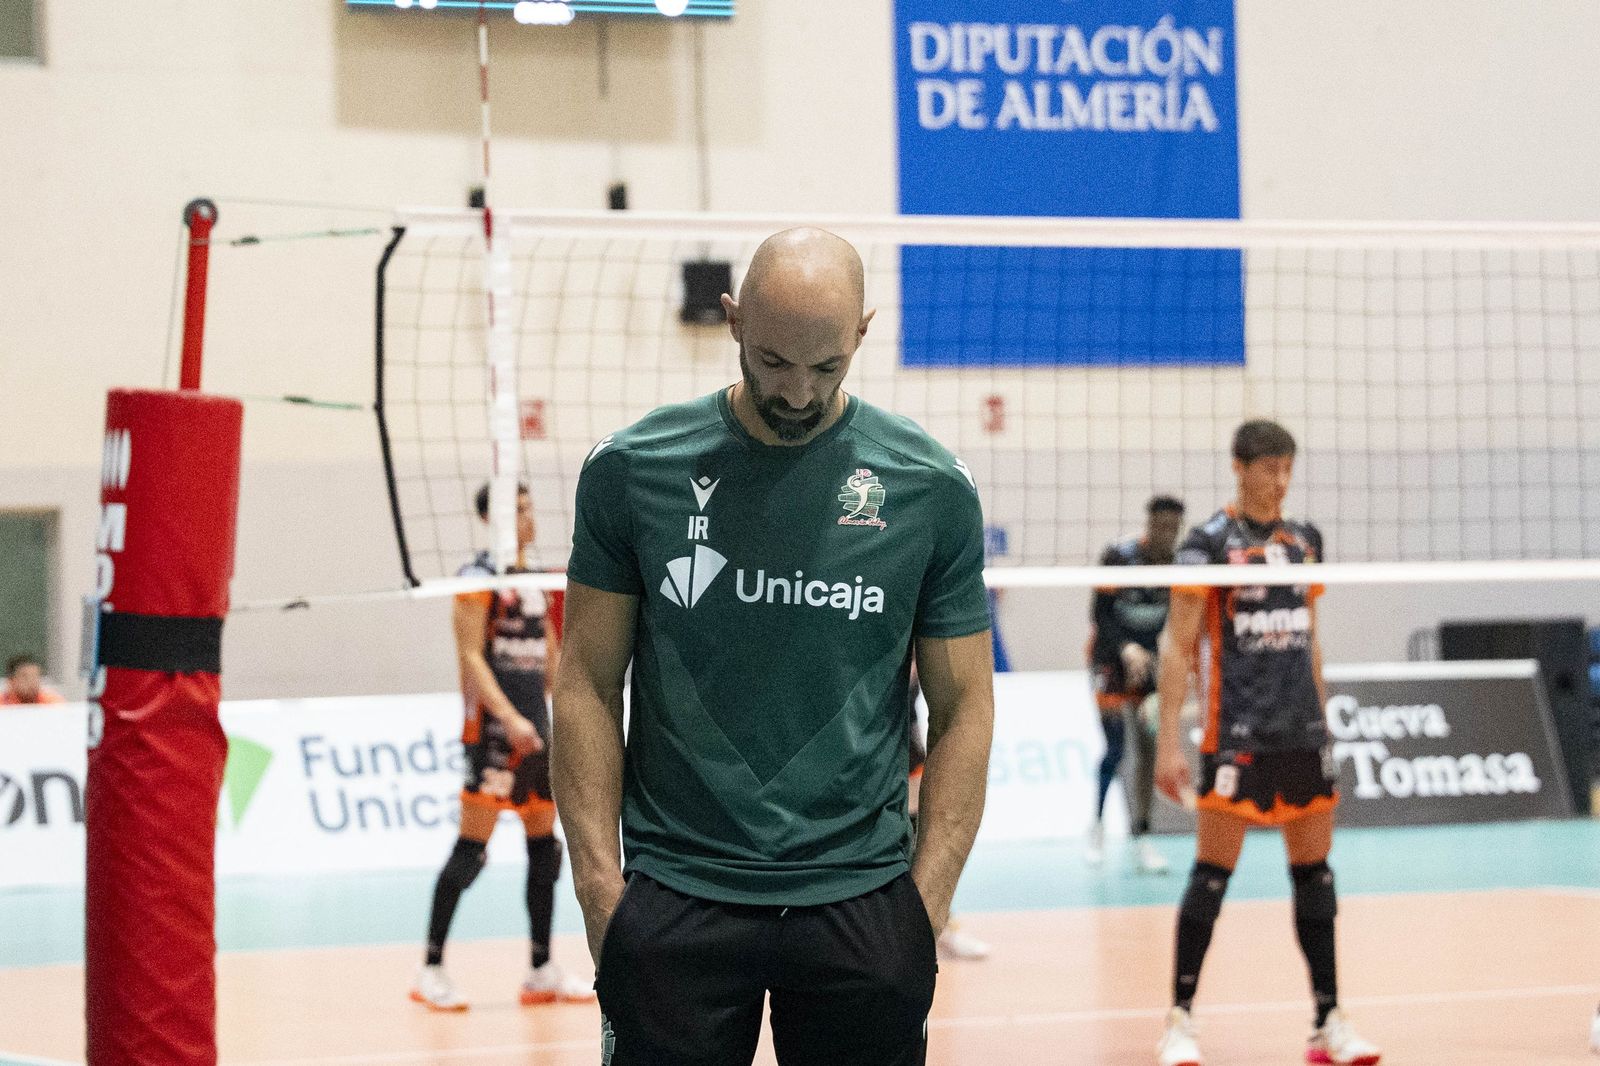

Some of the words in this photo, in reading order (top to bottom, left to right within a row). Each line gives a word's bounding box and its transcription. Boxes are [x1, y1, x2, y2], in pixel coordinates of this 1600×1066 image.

[907, 14, 1223, 76] DIPUTACIÓN
[915, 78, 987, 130] DE
[995, 72, 1219, 133] ALMERÍA
[687, 515, 709, 540] IR
[735, 568, 884, 620] Unicaja
[1329, 694, 1449, 740] Cueva
[1331, 740, 1542, 799] Tomasa
